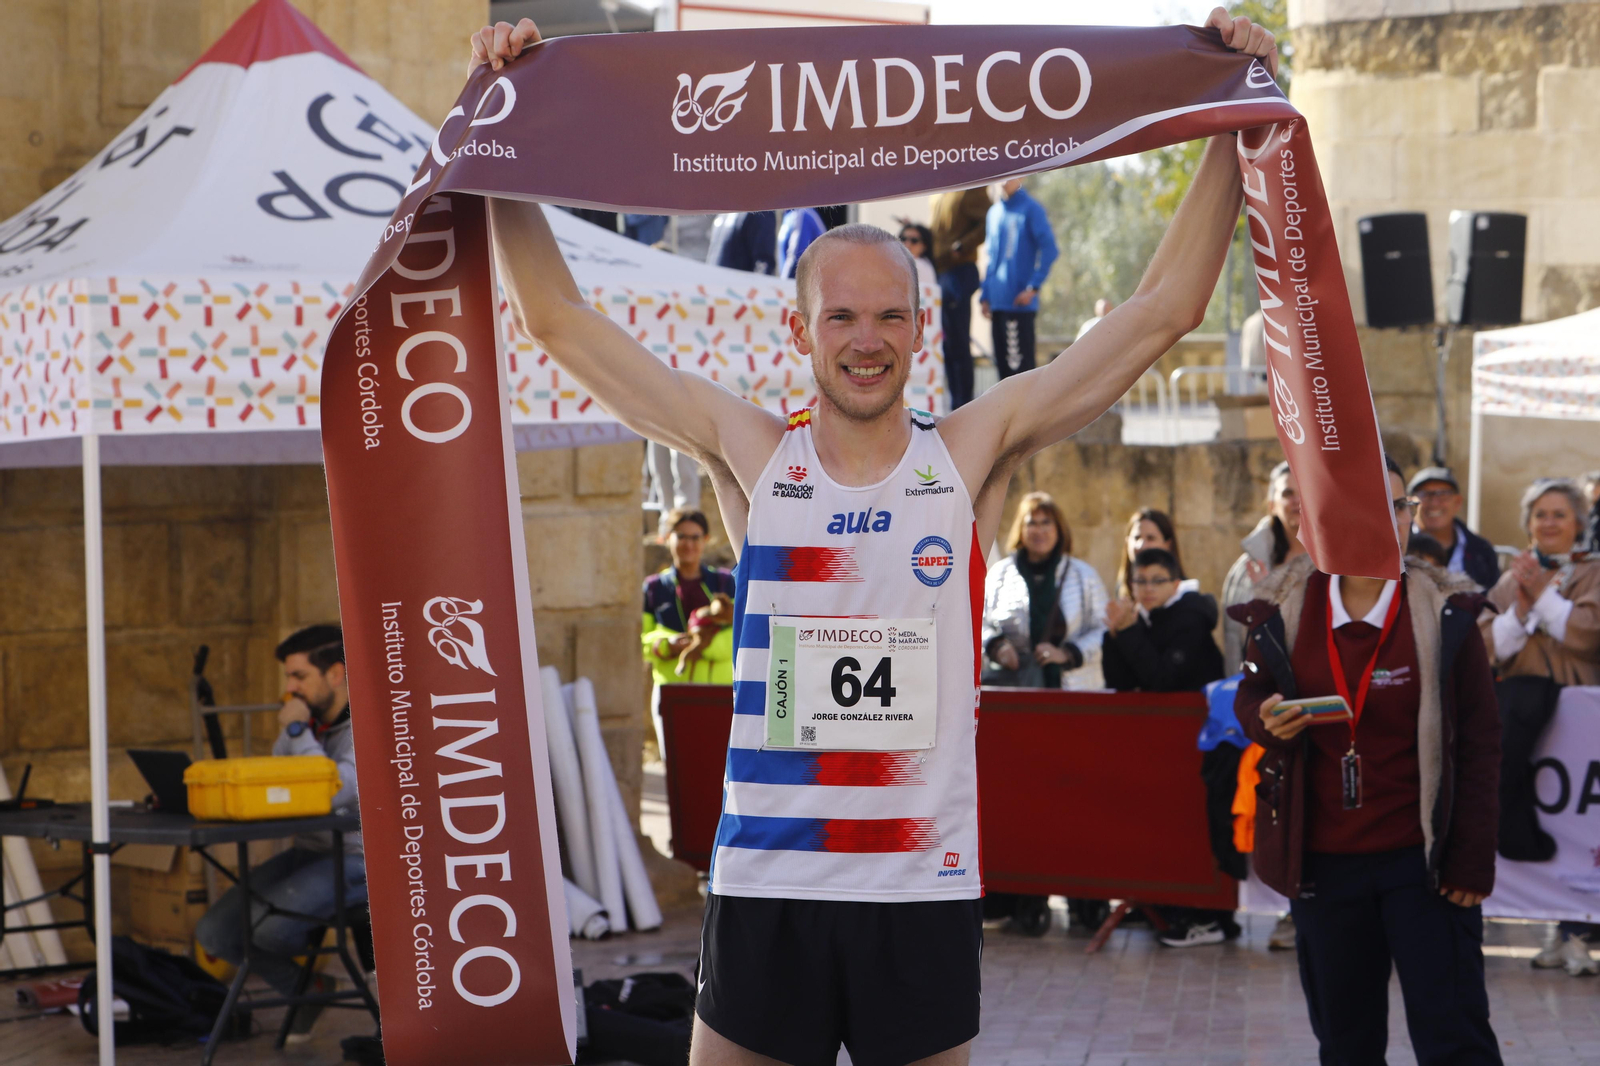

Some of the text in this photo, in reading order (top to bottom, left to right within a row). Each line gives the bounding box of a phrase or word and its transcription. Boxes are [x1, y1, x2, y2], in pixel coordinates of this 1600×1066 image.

[768, 47, 1092, 133] IMDECO
[673, 136, 1090, 174] Instituto Municipal de Deportes Córdob
[1279, 149, 1307, 241] Deportes
[1287, 246, 1307, 273] de
[1290, 276, 1326, 370] Municipal
[357, 362, 384, 450] Córdoba
[1312, 375, 1341, 451] Instituto
[773, 481, 814, 492] DIPUTACIÓN
[780, 490, 812, 499] BADAJOZ
[905, 485, 954, 497] Extremadura
[826, 507, 892, 535] aula
[918, 556, 949, 567] CAPEX
[817, 629, 882, 643] IMDECO
[888, 635, 929, 644] 36 MARATÓN
[774, 669, 788, 719] CAJÓN
[830, 656, 897, 708] 64
[811, 712, 914, 721] JORGE GONZÁLEZ RIVERA
[381, 601, 437, 1011] Instituto Municipal de Deportes Córdoba
[430, 688, 521, 1008] IMDECO
[945, 854, 959, 866] IN
[937, 868, 967, 877] INVERSE
